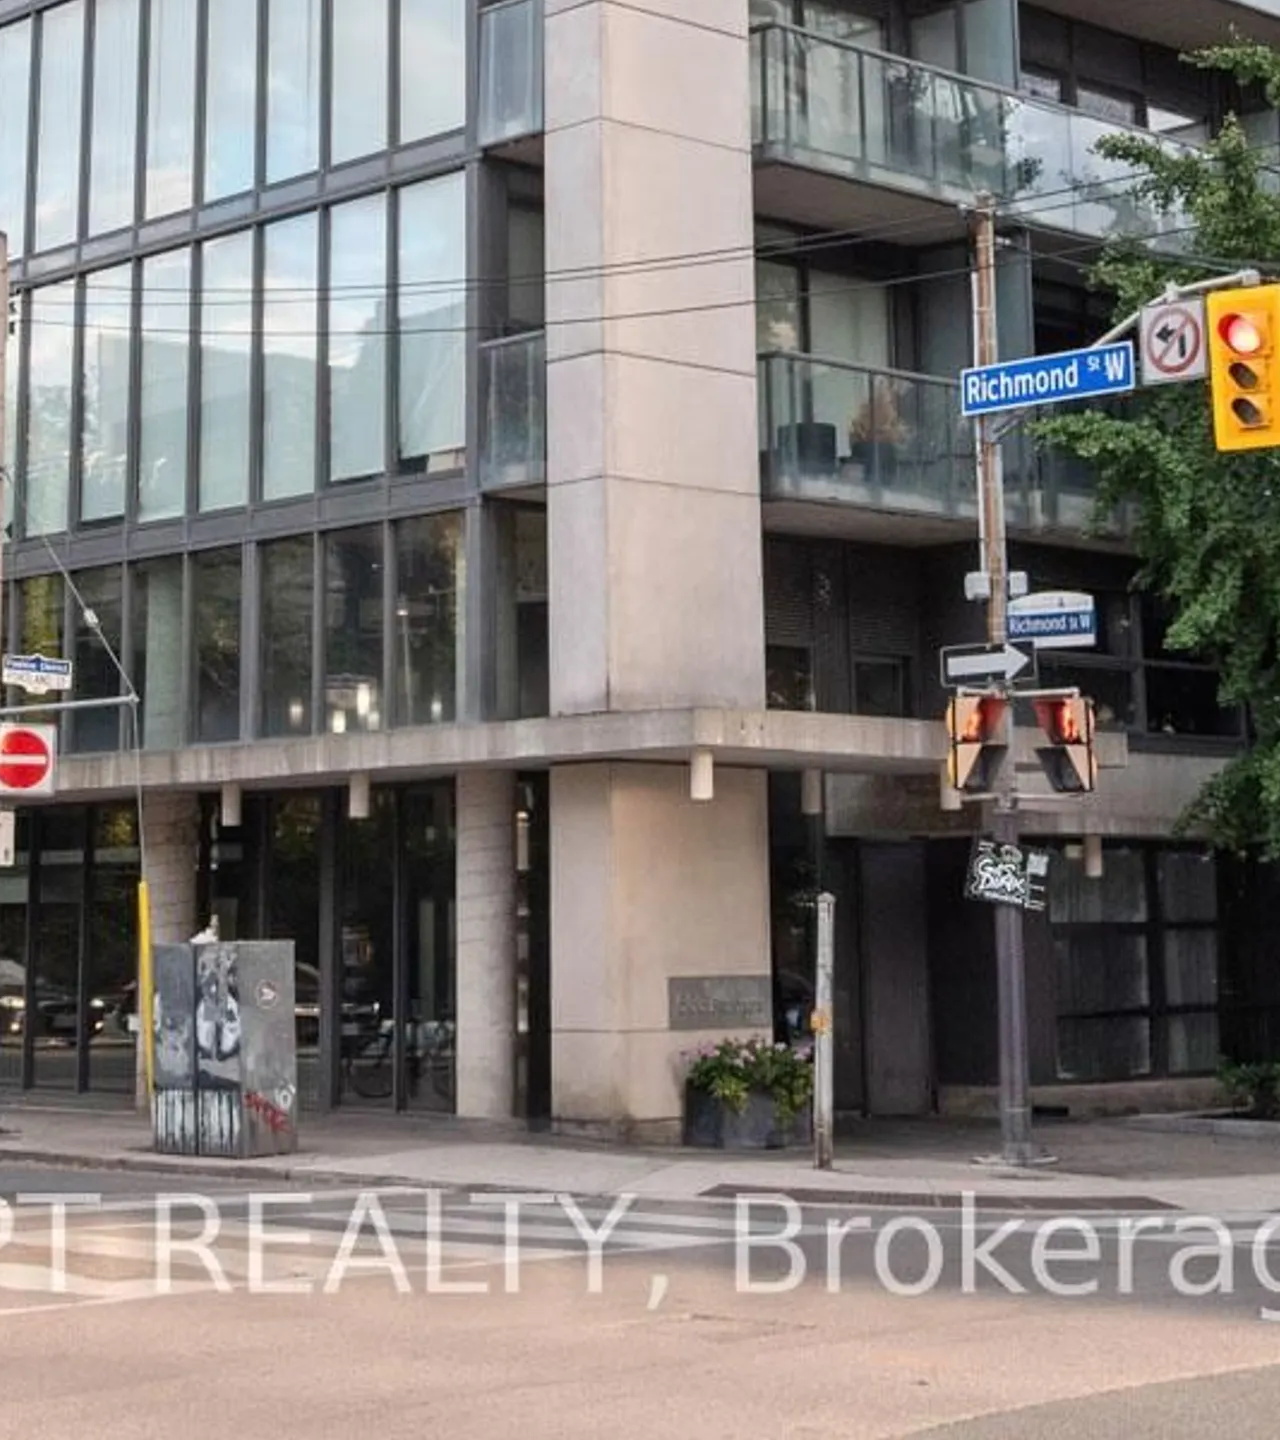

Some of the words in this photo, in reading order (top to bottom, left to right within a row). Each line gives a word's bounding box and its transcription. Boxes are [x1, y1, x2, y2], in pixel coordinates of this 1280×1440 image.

[967, 359, 1078, 404] Richmond
[1087, 356, 1100, 371] St
[1104, 350, 1125, 381] W
[1010, 615, 1066, 634] Richmond
[1079, 614, 1090, 628] W
